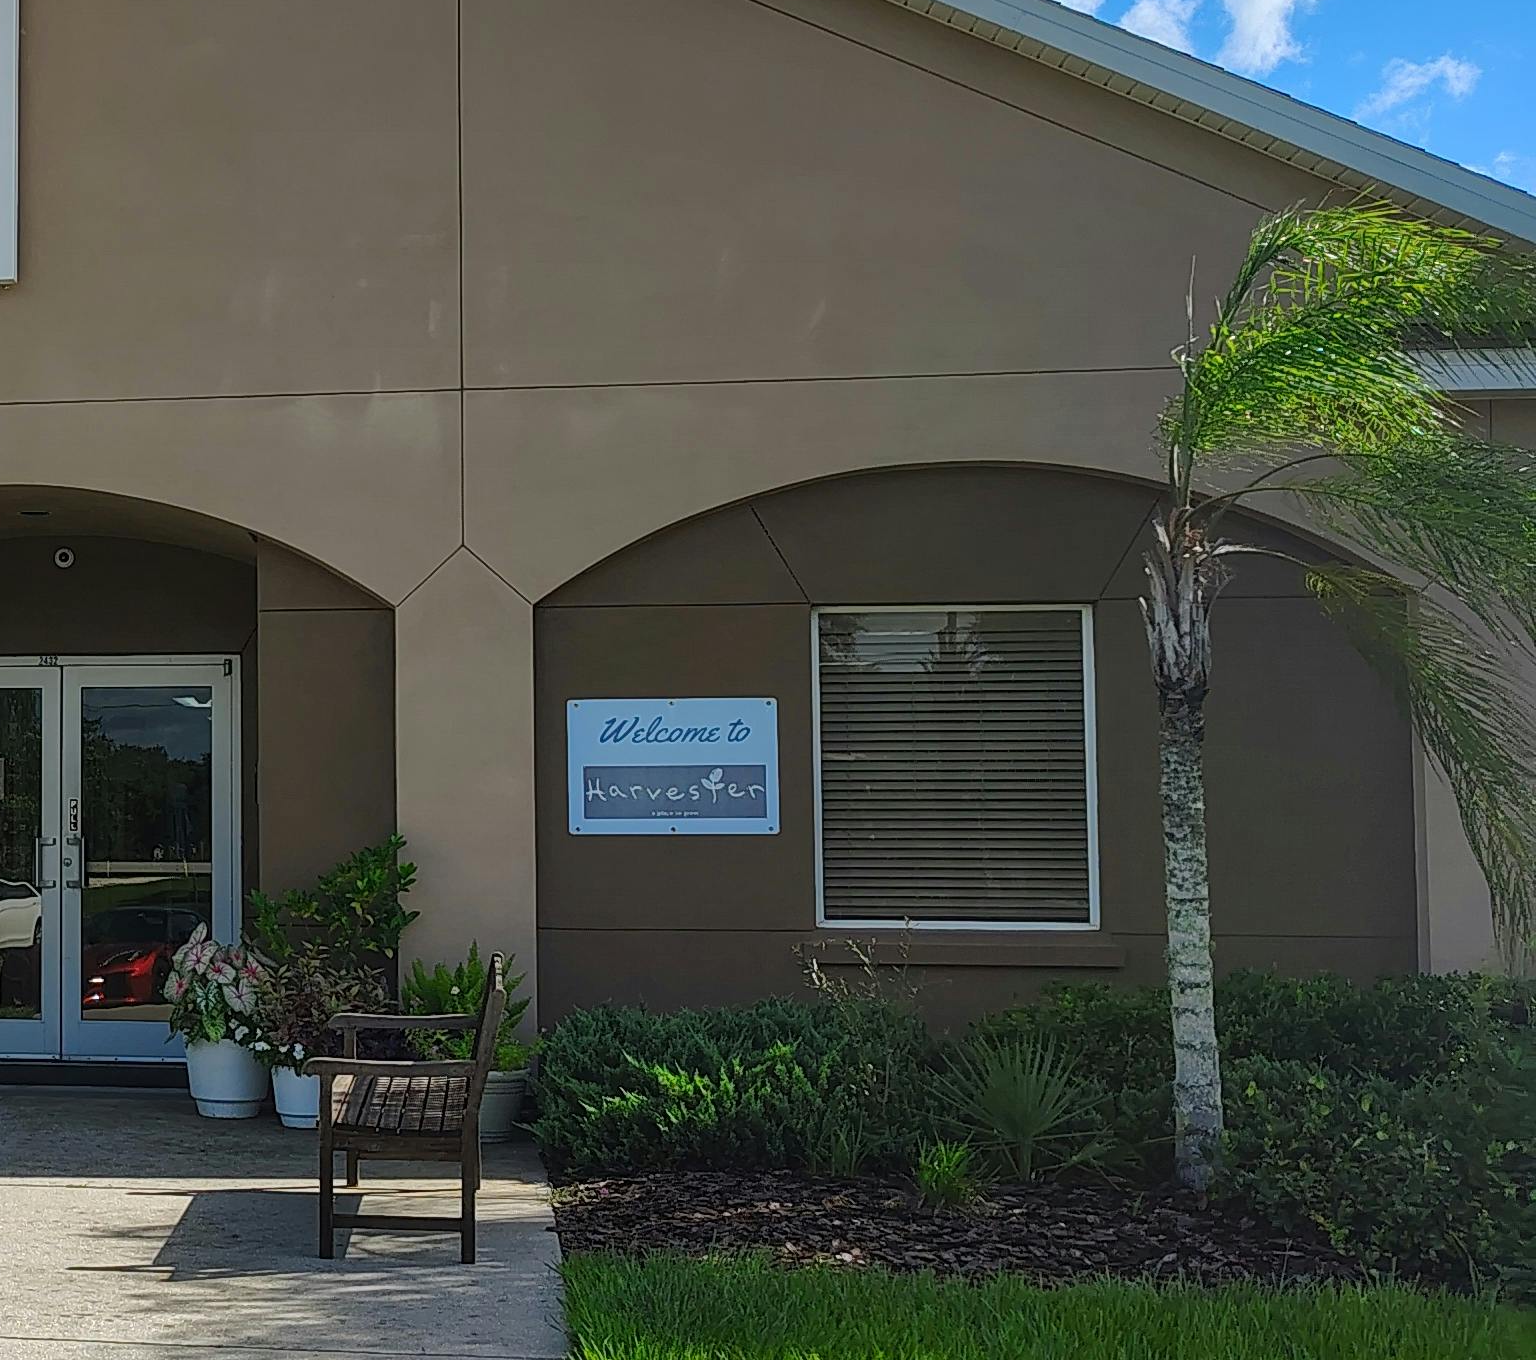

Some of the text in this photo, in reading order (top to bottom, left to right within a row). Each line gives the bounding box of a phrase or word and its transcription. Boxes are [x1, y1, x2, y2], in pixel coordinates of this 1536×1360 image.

[599, 716, 751, 744] Welcome to
[585, 768, 765, 804] Harvester
